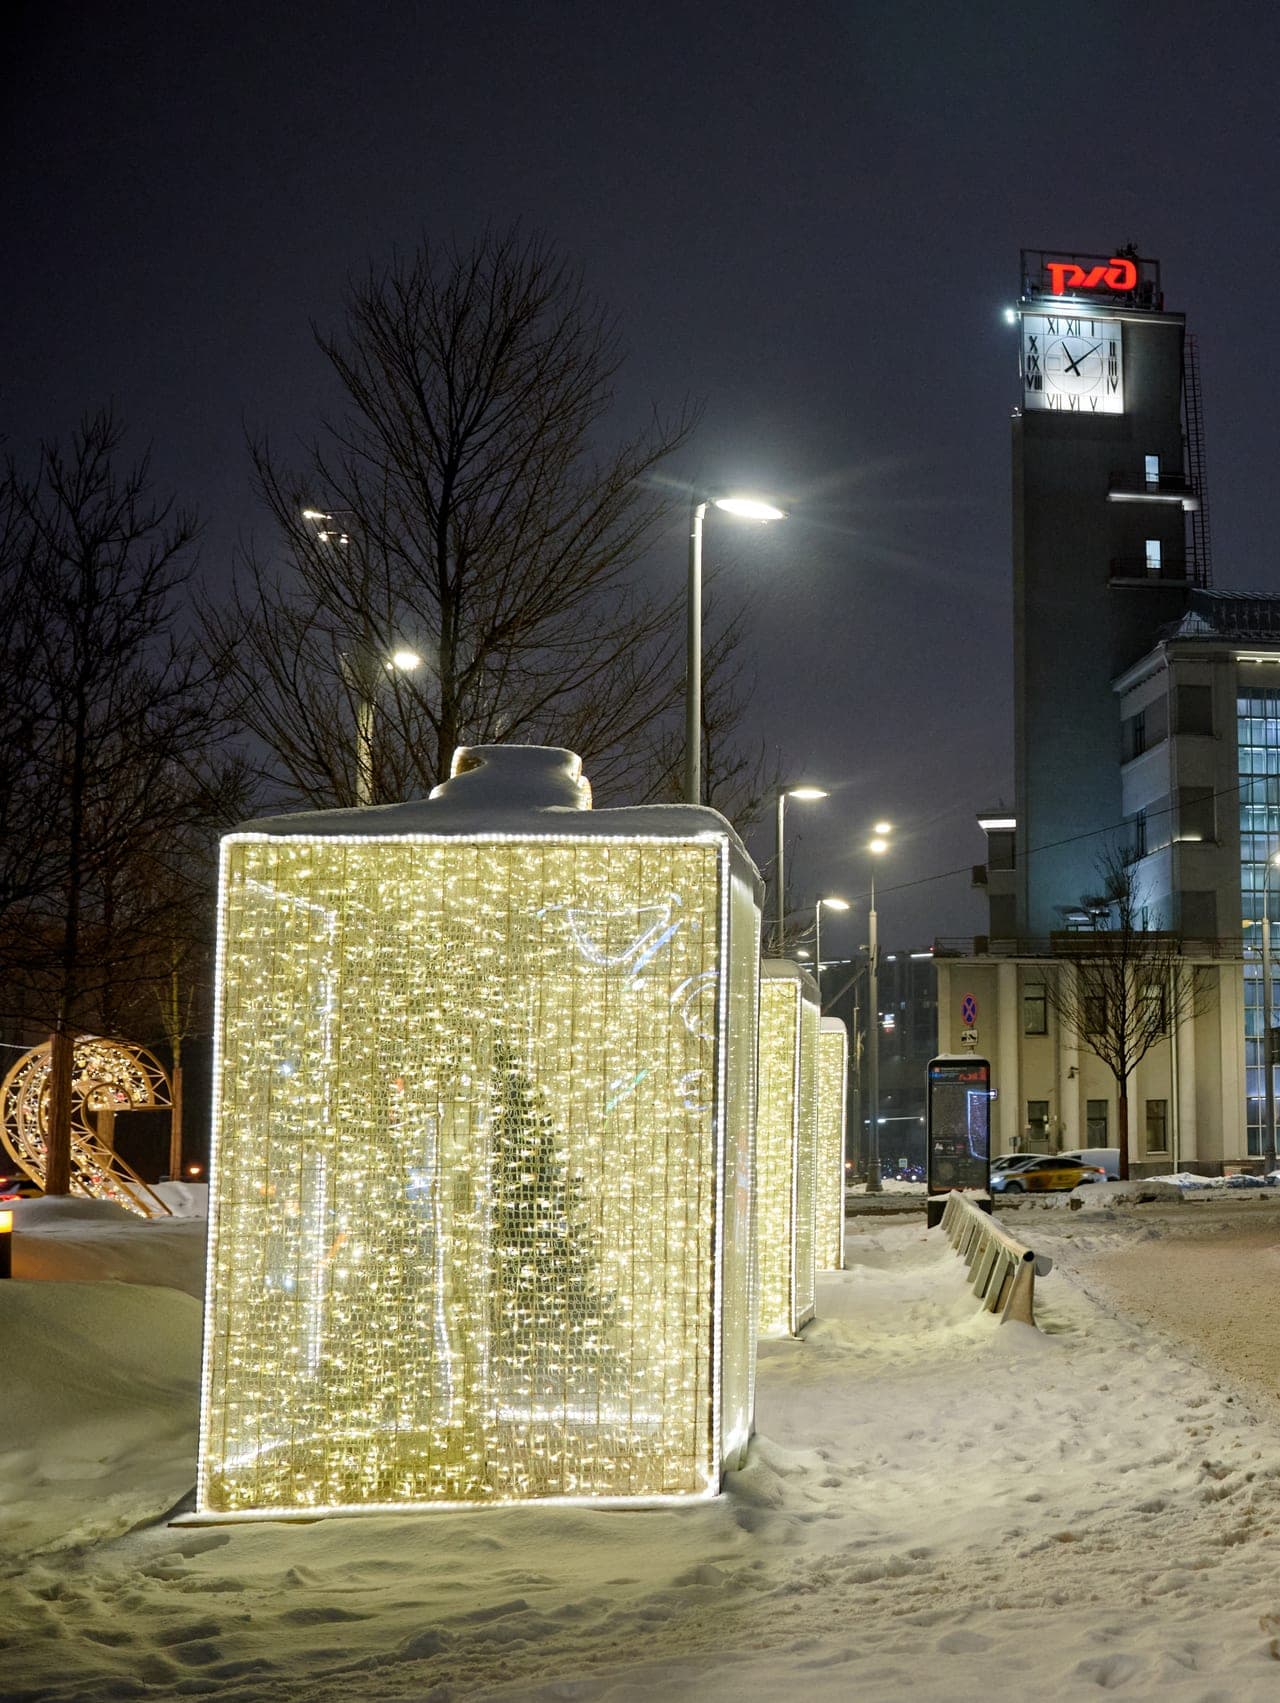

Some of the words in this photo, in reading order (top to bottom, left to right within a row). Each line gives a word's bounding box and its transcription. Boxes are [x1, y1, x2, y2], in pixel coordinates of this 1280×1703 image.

[1047, 317, 1059, 336] XI
[1066, 318, 1081, 337] XII
[1029, 335, 1038, 354] X
[1109, 341, 1116, 357] II
[1027, 354, 1040, 372] IX
[1108, 359, 1117, 377] III
[1026, 374, 1043, 391] VIII
[1106, 376, 1119, 396] IV
[1046, 392, 1062, 412] VII
[1068, 393, 1081, 413] VI
